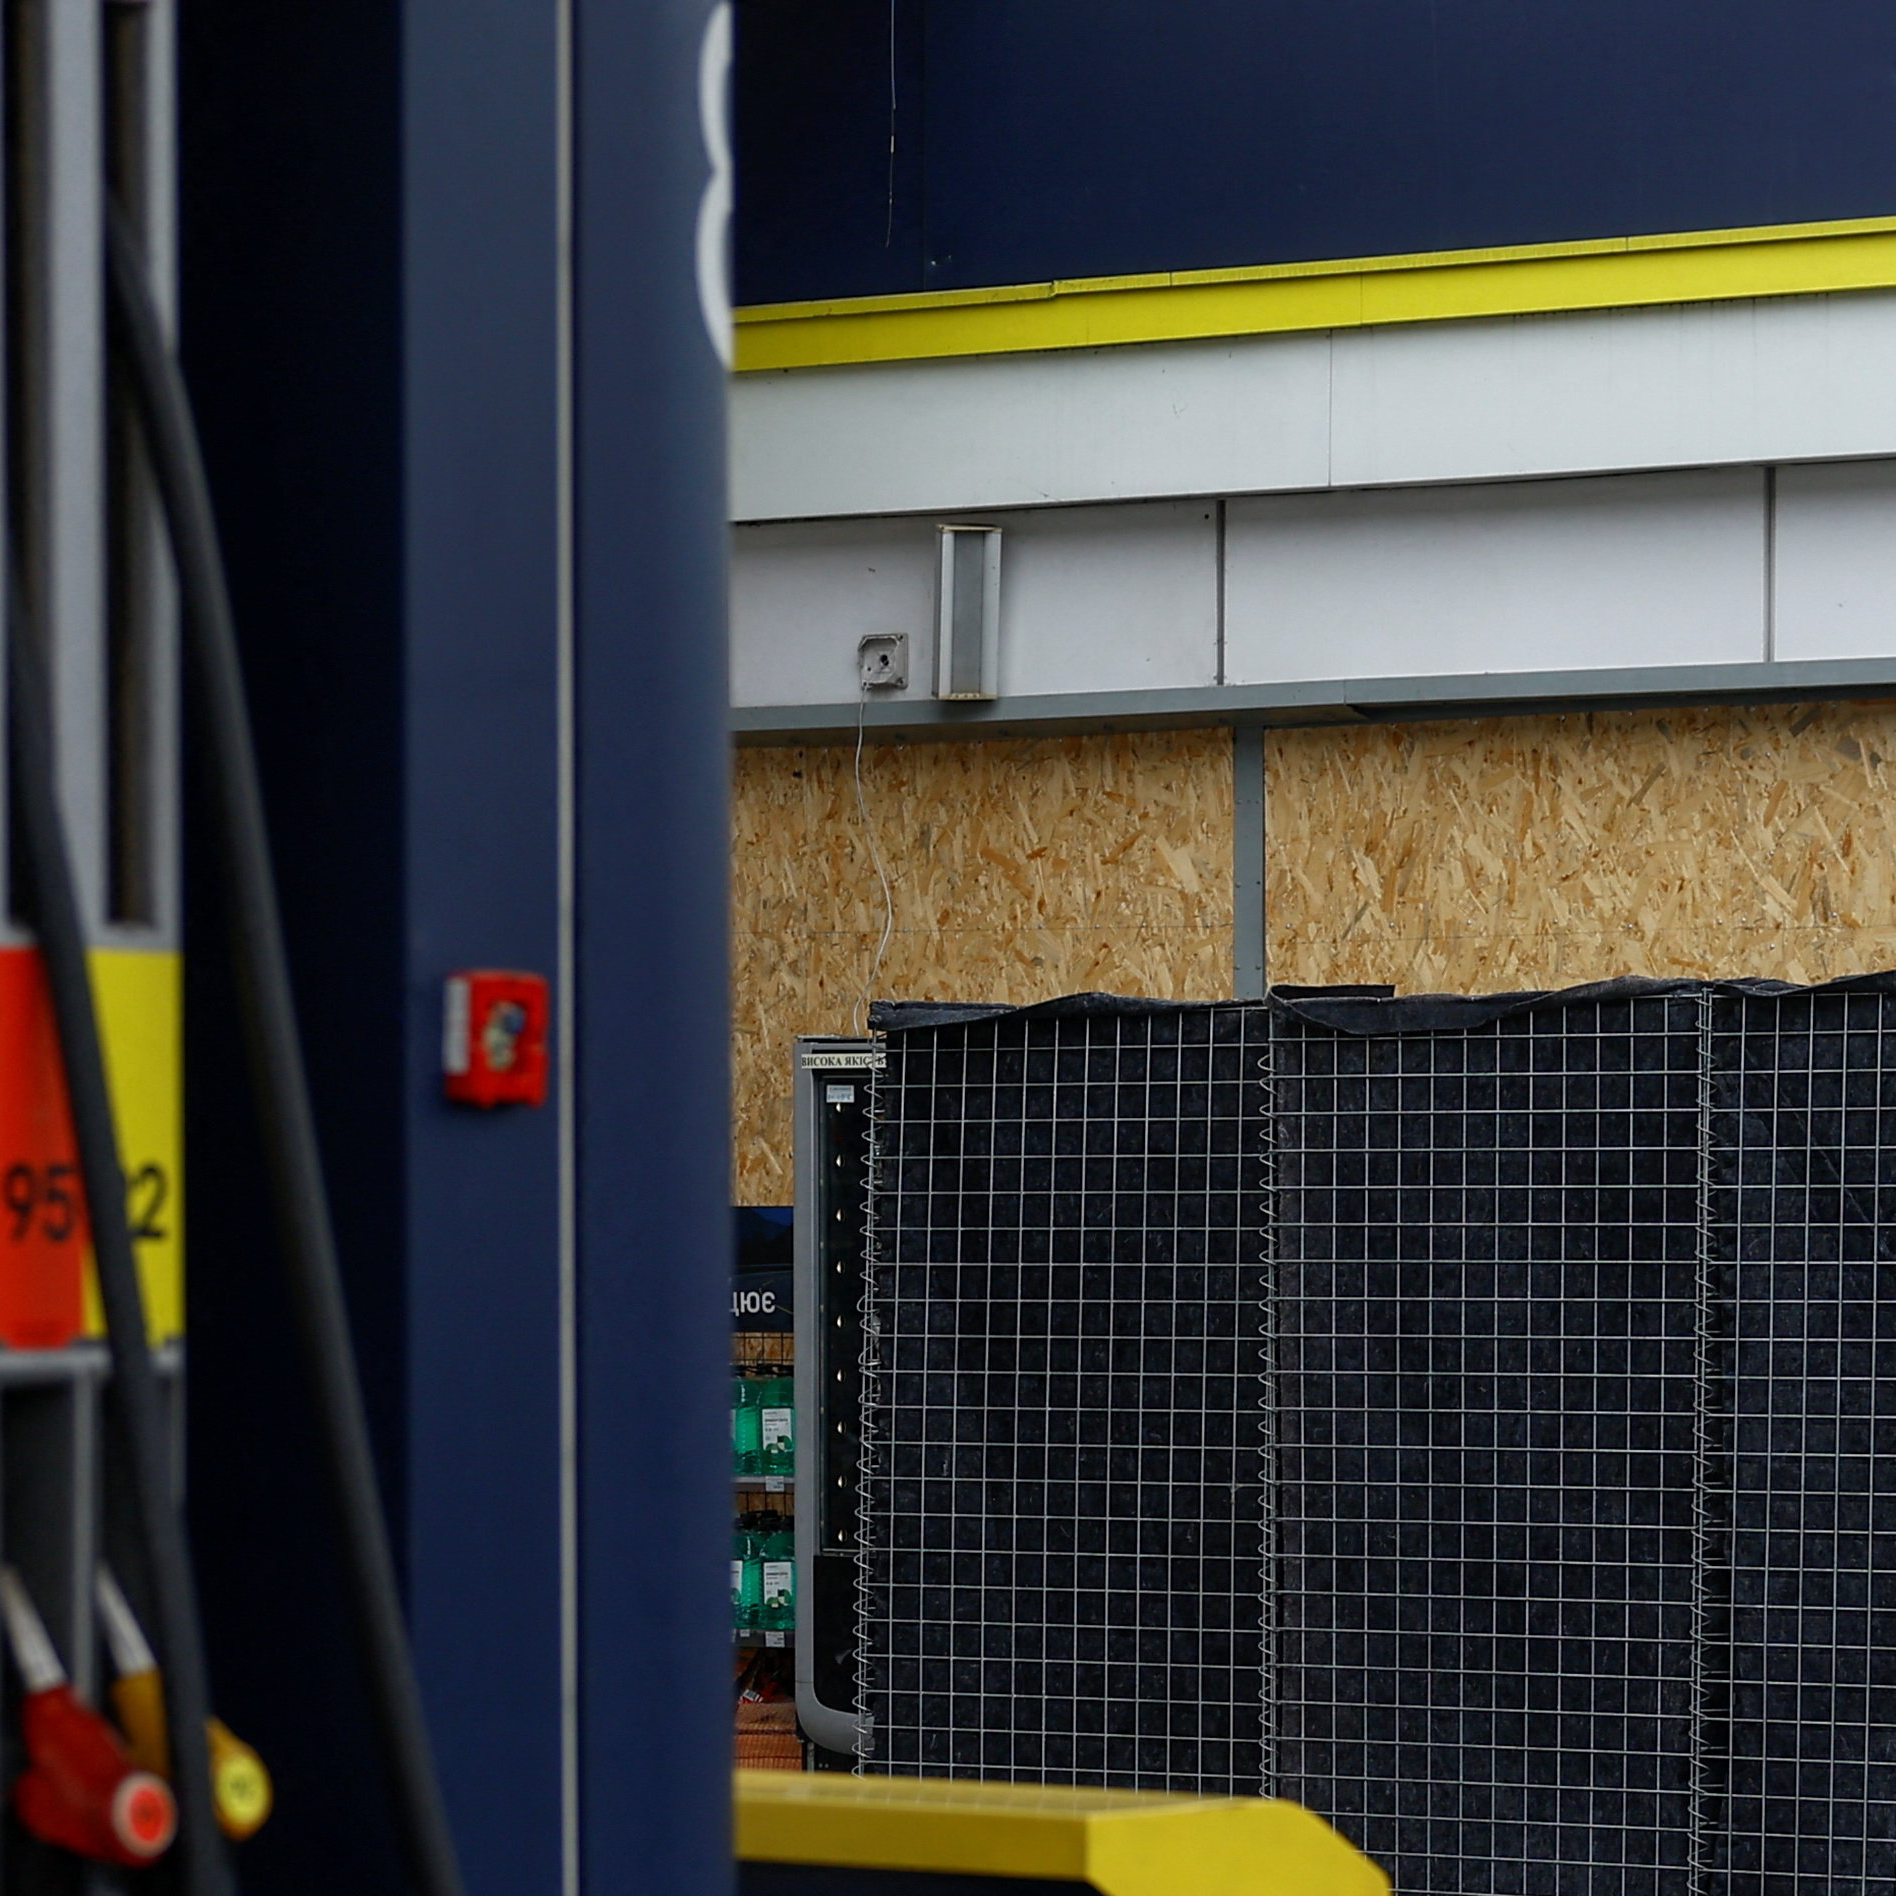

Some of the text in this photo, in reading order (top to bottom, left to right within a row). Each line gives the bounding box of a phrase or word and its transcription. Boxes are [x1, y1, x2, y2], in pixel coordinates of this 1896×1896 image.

[802, 1056, 884, 1067] ВИСОКА ЯКІСЬ
[5, 1163, 77, 1241] 95
[126, 1163, 168, 1240] 2
